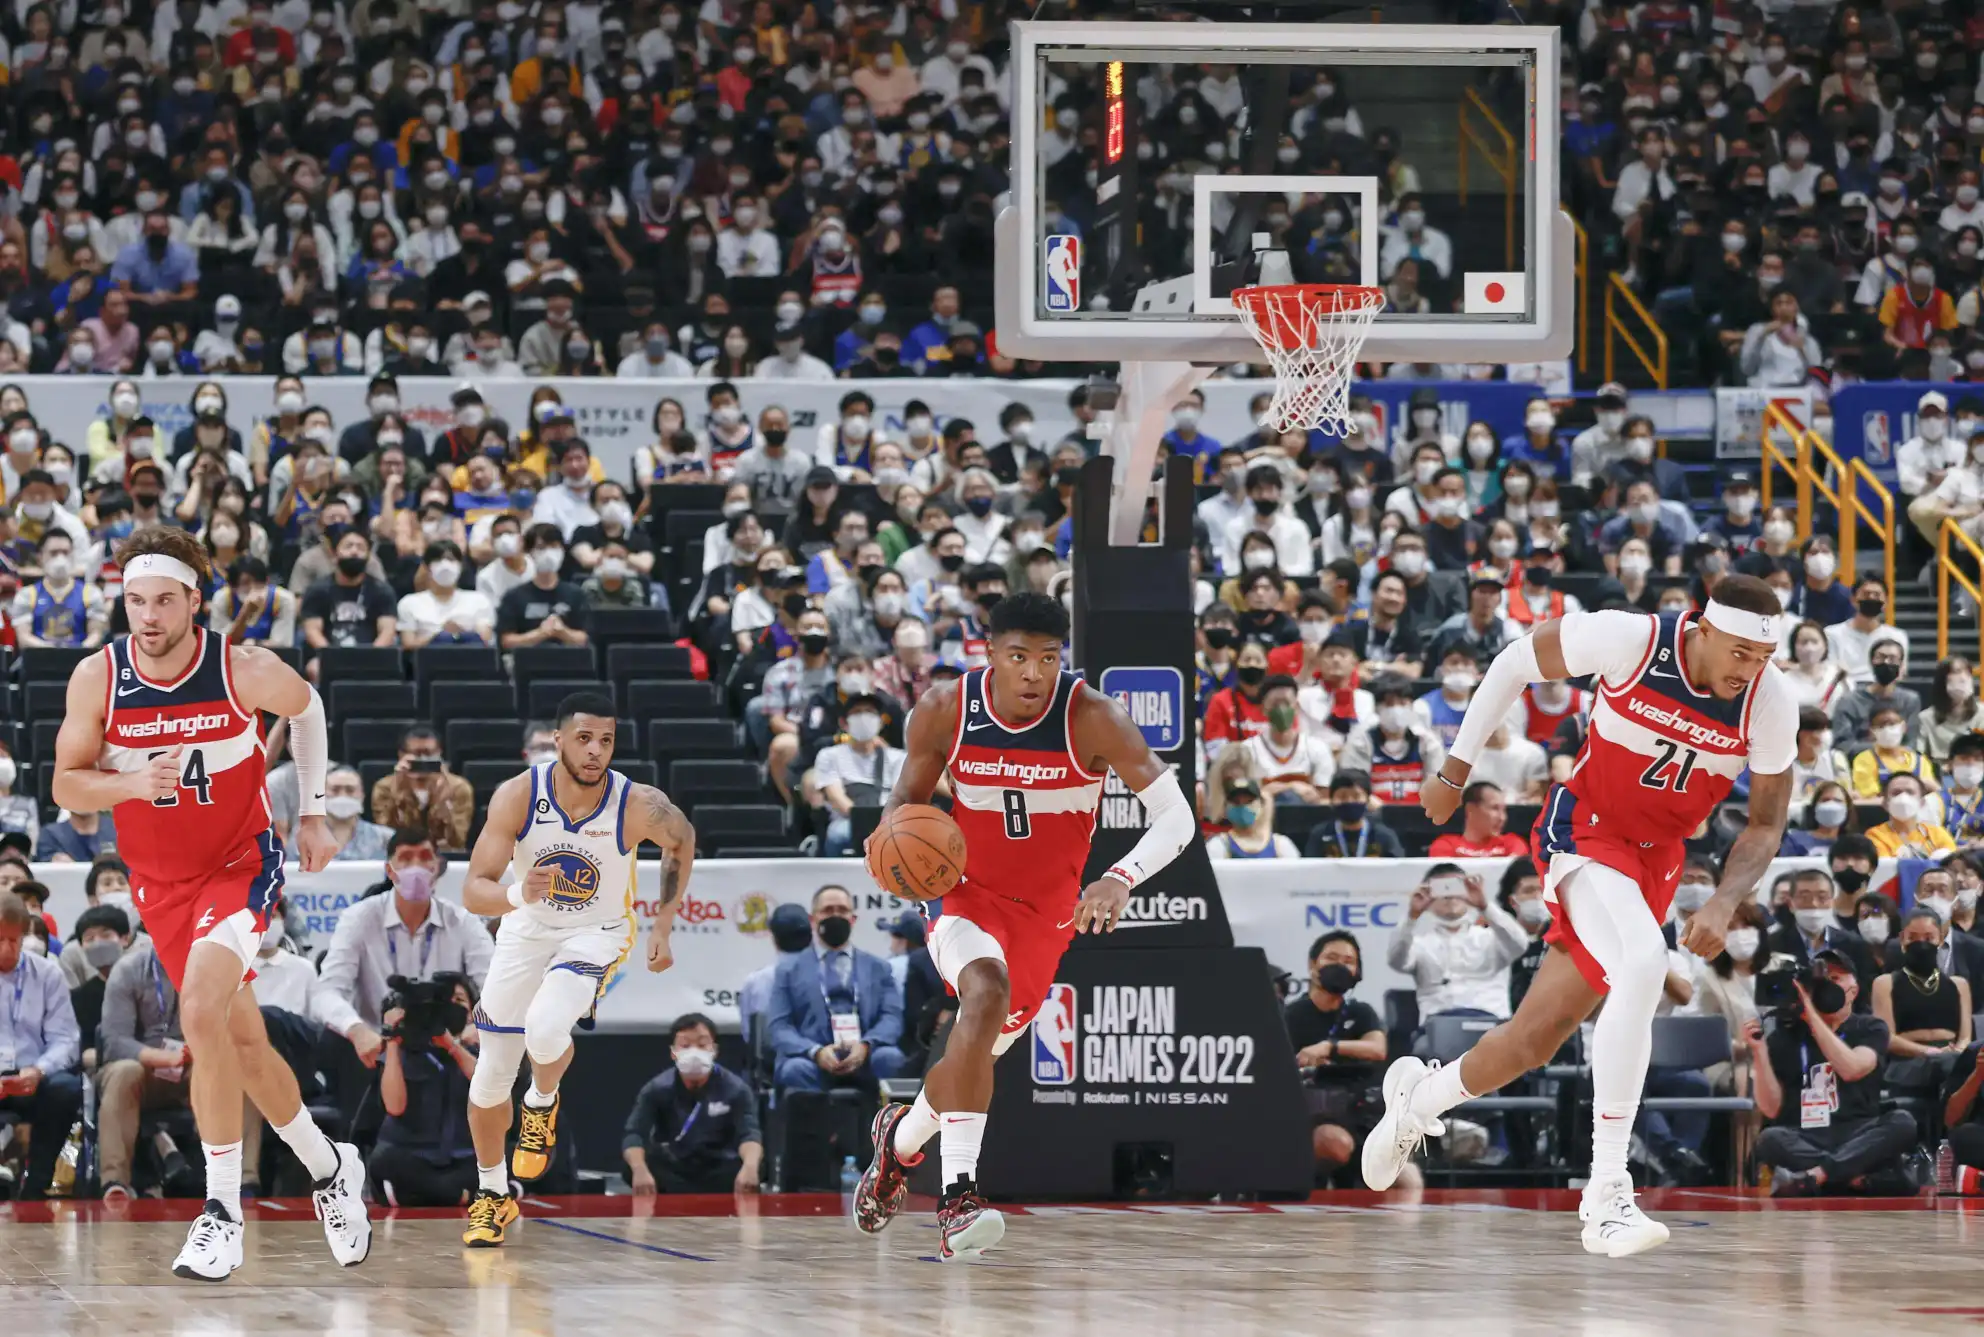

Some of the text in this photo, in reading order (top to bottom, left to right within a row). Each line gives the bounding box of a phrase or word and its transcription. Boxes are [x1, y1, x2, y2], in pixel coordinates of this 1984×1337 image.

[580, 408, 645, 422] STYLE
[1658, 648, 1671, 662] 6
[121, 668, 131, 680] 6
[970, 700, 980, 713] 6
[1130, 691, 1173, 727] NBA
[117, 712, 230, 738] washington
[1627, 697, 1742, 750] washington
[958, 756, 1068, 785] washington
[1639, 738, 1698, 793] 21
[538, 800, 548, 812] 6
[1002, 789, 1032, 840] 8
[1102, 798, 1141, 829] NBA
[584, 829, 612, 838] Rakuten
[535, 843, 603, 867] GOLDEN STATE
[574, 869, 592, 885] 12
[541, 896, 600, 912] ARRIORS
[1118, 892, 1208, 920] kuten
[1306, 902, 1399, 928] NEC
[1084, 986, 1176, 1034] JAPAN
[1037, 1060, 1060, 1078] NBA
[1083, 1035, 1255, 1084] GAMES 2022
[1032, 1089, 1063, 1103] Presented
[1083, 1091, 1229, 1105] Rakuten NISSAN
